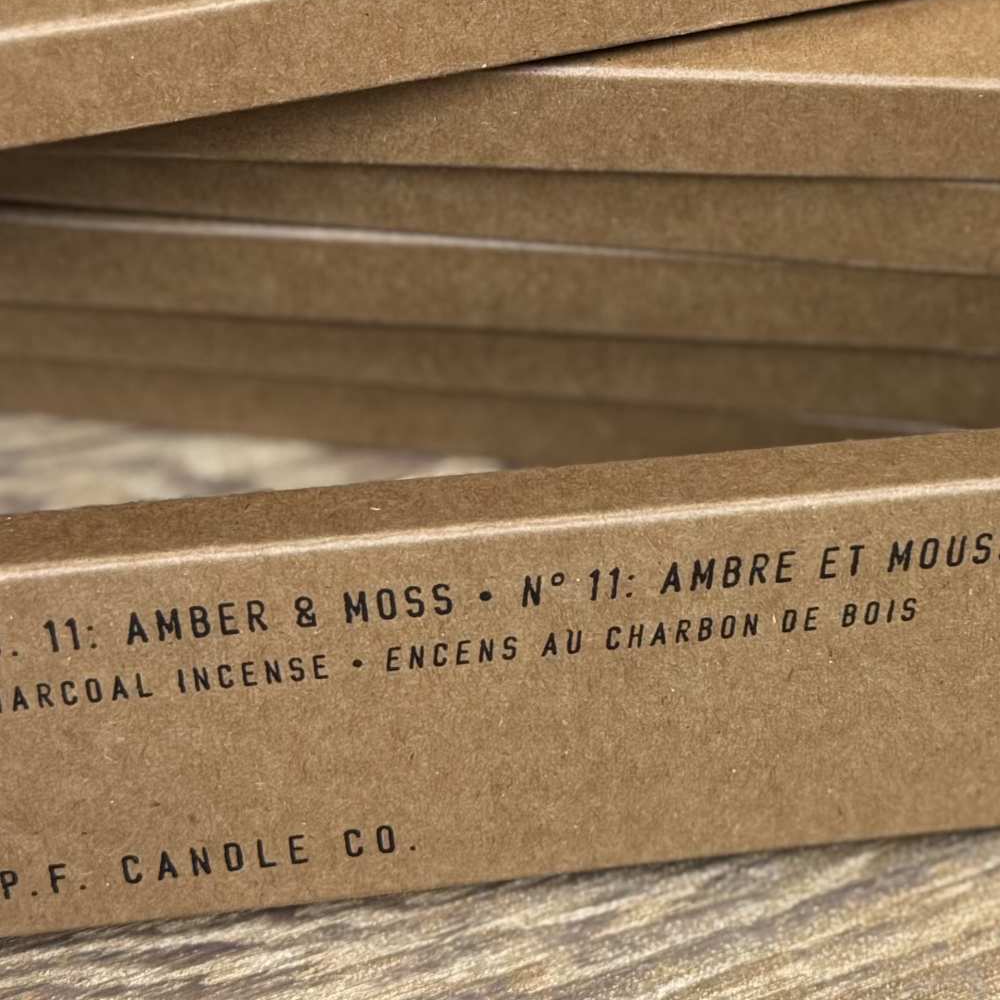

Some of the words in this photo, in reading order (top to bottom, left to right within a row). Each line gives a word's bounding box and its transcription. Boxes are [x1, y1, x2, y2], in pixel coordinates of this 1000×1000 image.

[43, 618, 97, 652] 11:
[127, 600, 268, 645] AMBER
[295, 596, 317, 628] &
[343, 584, 453, 624] MOSS
[589, 567, 634, 601] 11:
[660, 551, 796, 595] AMBRE
[819, 545, 865, 579] ET
[0, 673, 153, 713] ARCOAL
[177, 654, 328, 693] INCENSE
[386, 636, 517, 672] ENCENS
[541, 629, 582, 657] AU
[606, 613, 758, 650] CHARBON
[782, 607, 819, 633] DE
[842, 598, 917, 628] BOIS
[0, 863, 86, 899] P.F.
[121, 835, 309, 884] CANDLE
[343, 825, 415, 857] CO.
